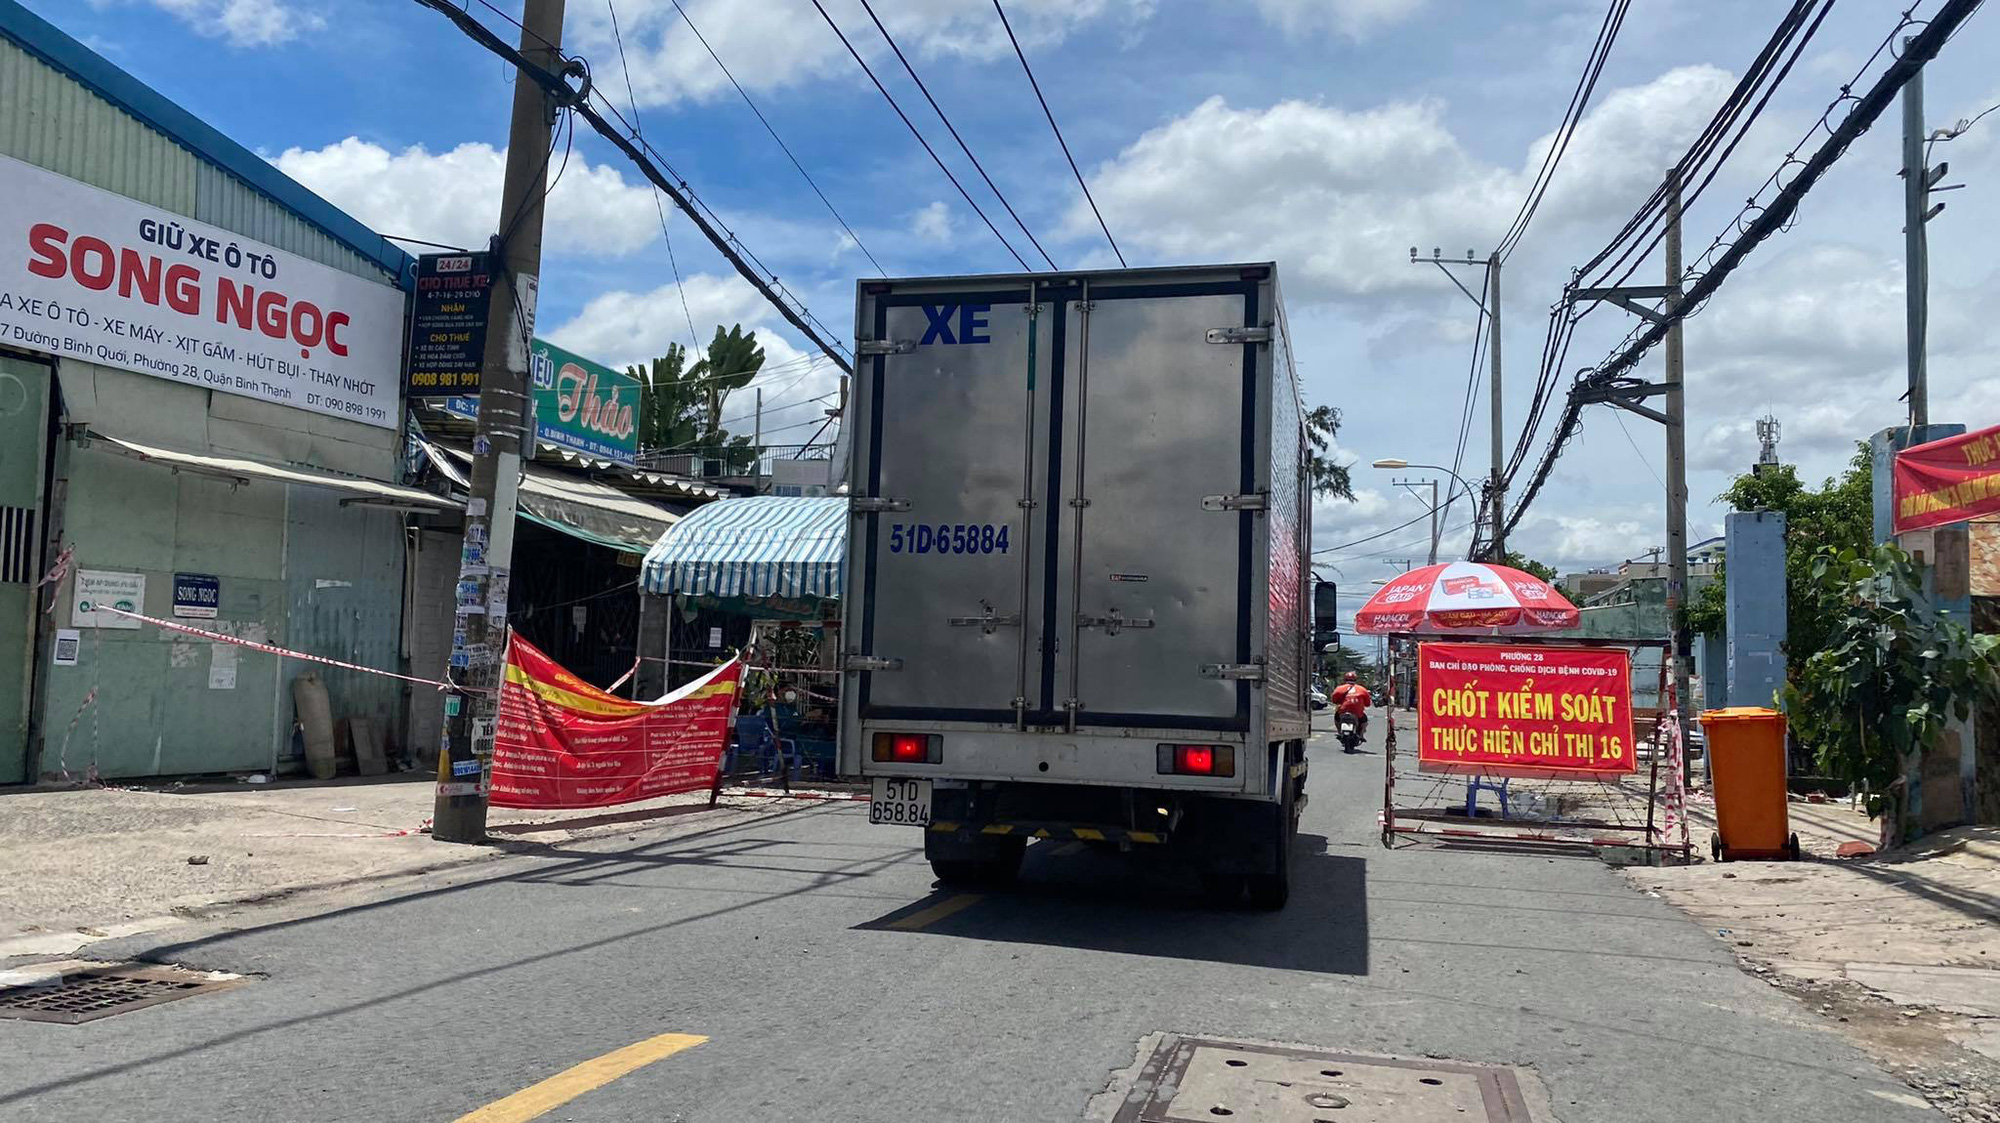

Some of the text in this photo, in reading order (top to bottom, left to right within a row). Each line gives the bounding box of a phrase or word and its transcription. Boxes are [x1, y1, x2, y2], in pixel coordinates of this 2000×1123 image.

[139, 218, 277, 280] GIỮ XE Ô TÔ
[439, 259, 470, 270] 24/24
[27, 223, 350, 360] SONG NGỌC
[419, 276, 442, 290] CHO
[473, 274, 487, 288] XE
[920, 302, 991, 345] XE
[18, 296, 43, 316] XE
[47, 301, 61, 320] Ô
[66, 308, 89, 327] TÔ
[103, 317, 125, 336] XE
[130, 324, 164, 345] MÁY
[175, 335, 200, 355] XỊT
[247, 353, 275, 371] HÚT
[278, 361, 300, 379] BỤI
[309, 368, 341, 388] THAY
[430, 333, 448, 342] CHO
[14, 326, 59, 350] Đường
[64, 337, 93, 355] Bình
[134, 353, 179, 376] Phường
[182, 363, 200, 380] 28,
[203, 369, 232, 388] Quận
[261, 382, 292, 400] Thạnh
[411, 372, 480, 386] 0908 981 991
[325, 397, 343, 411] 090
[346, 402, 363, 416] 898
[365, 407, 386, 421] 1991
[557, 362, 634, 440] Thảo
[177, 585, 197, 602] SONG
[1386, 584, 1427, 595] JAPAN
[1374, 613, 1410, 623] HAPACOL
[1500, 651, 1544, 661] PHƯỜNG 28
[1429, 661, 1618, 677] BAN CHỈ ĐẠO PHÒNG, CHỐNG DỊCH BỆNH COVID-19
[1433, 677, 1616, 725] CHỐT KIỂM SOÁT
[1431, 723, 1623, 764] THỰC HIỆN CHỈ THỊ 16
[886, 780, 918, 801] 51D
[872, 801, 929, 823] 658.84
